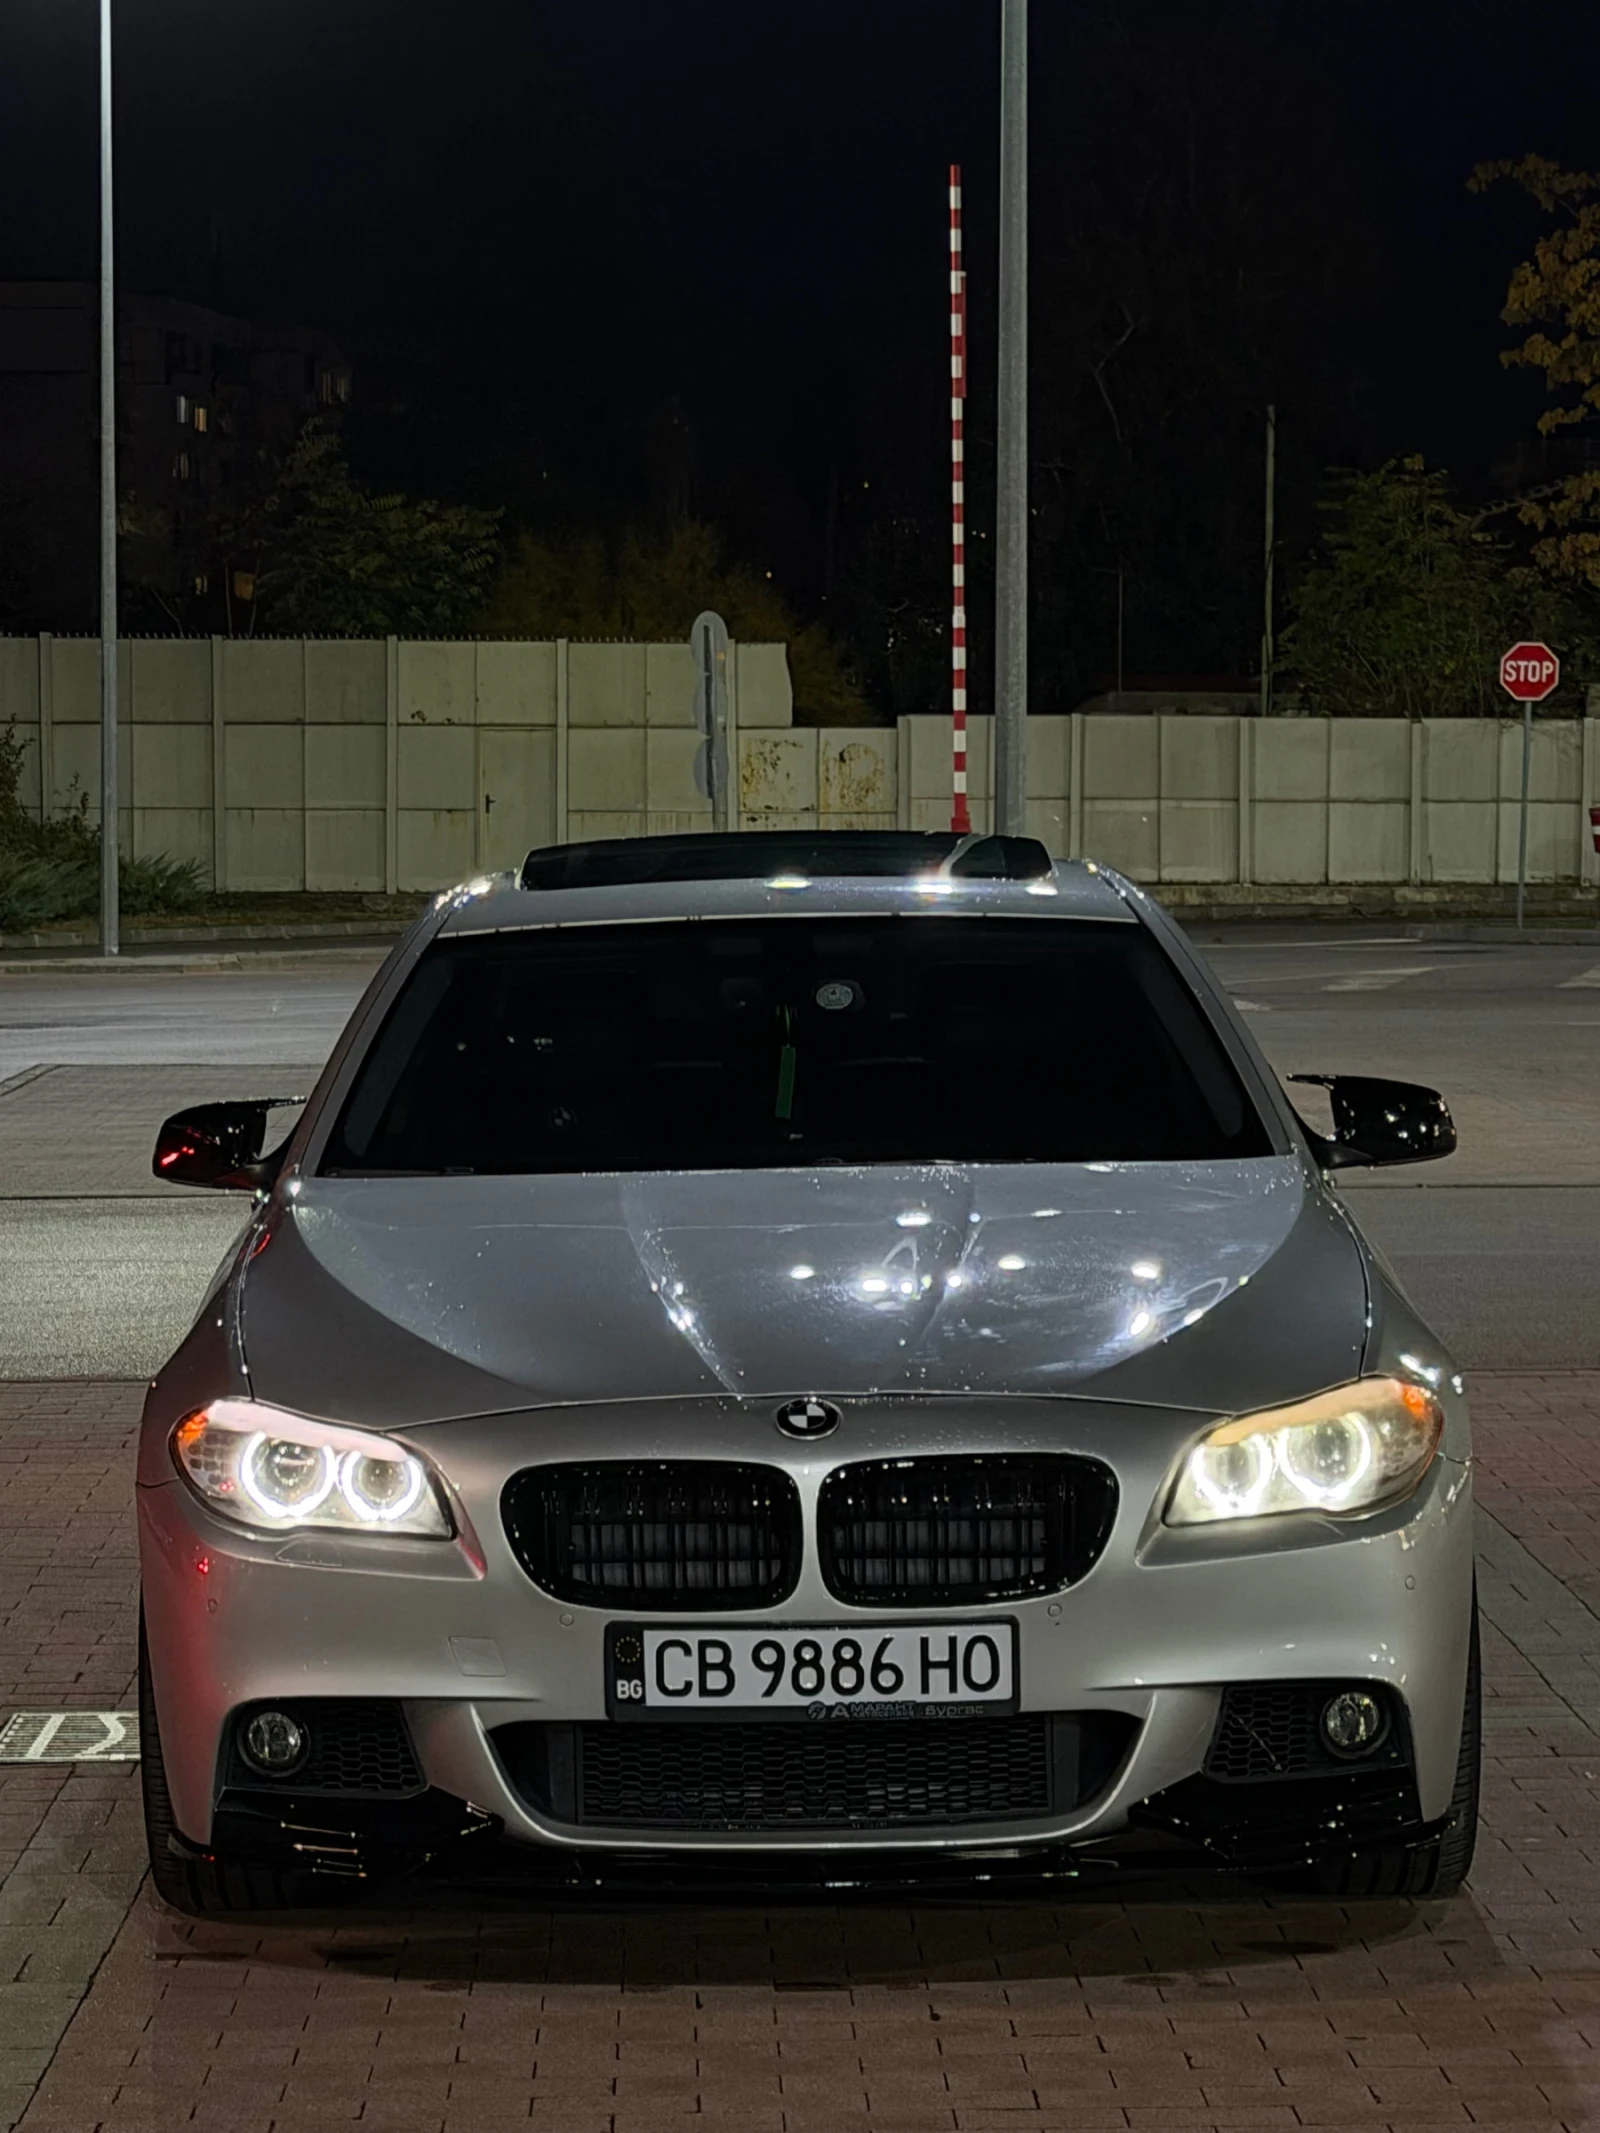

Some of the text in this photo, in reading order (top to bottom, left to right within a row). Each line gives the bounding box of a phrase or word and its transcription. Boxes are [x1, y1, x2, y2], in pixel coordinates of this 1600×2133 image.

[1504, 660, 1554, 683] STOP
[655, 1634, 1000, 1698] CB 9886 HO
[616, 1679, 643, 1700] BG
